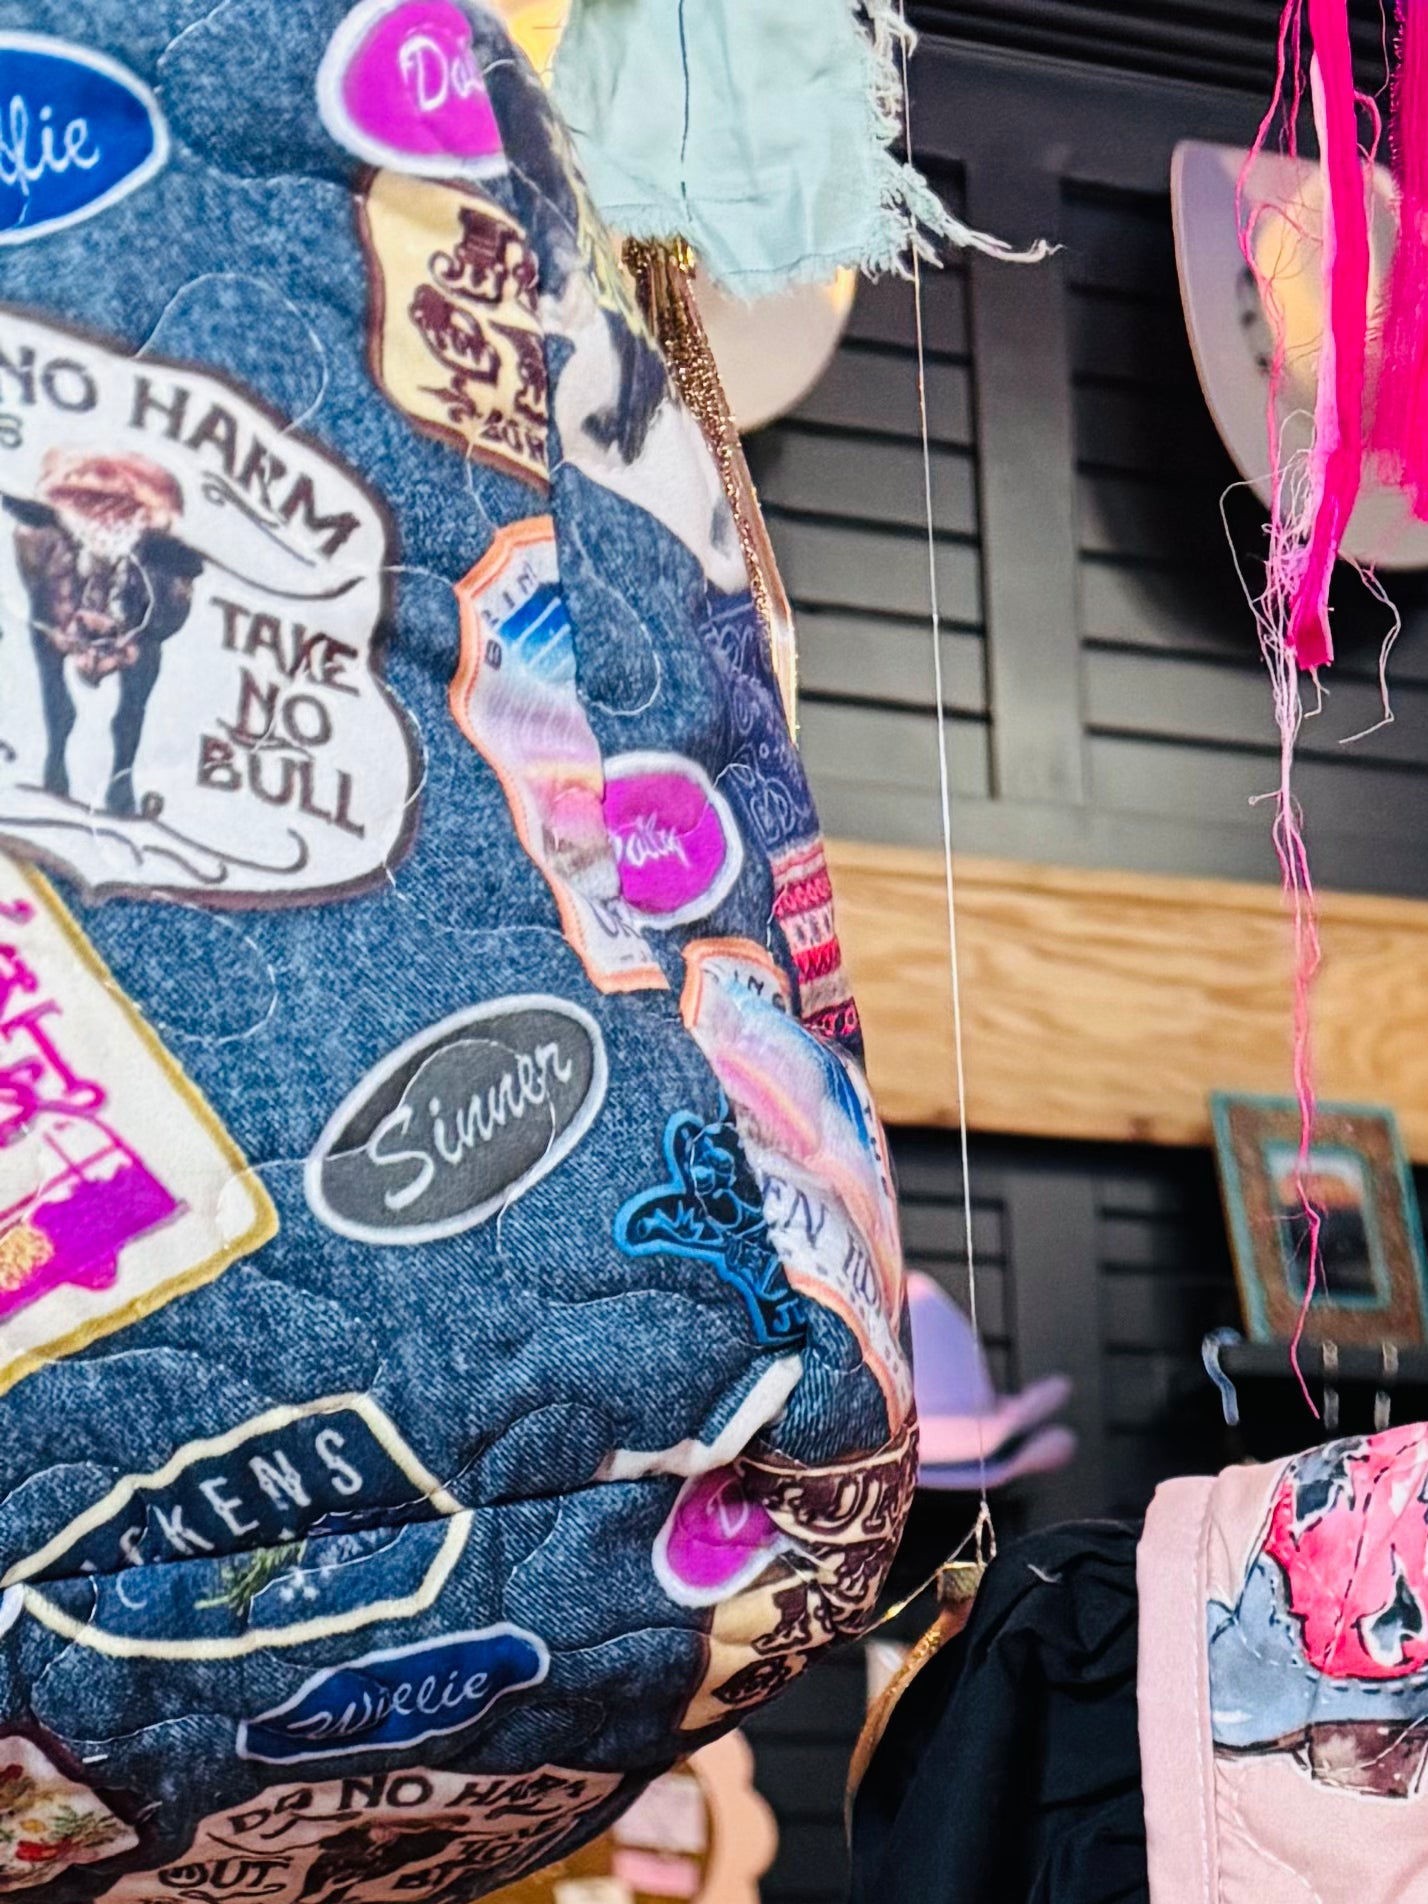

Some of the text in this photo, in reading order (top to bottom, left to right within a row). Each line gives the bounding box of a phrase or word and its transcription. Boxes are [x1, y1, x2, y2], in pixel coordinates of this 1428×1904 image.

[129, 374, 361, 563] HARM
[208, 597, 361, 697] TAKE
[235, 668, 334, 750] NO
[197, 733, 366, 839] BULL
[368, 1042, 573, 1210] Sinner
[286, 1668, 490, 1740] Willie
[340, 1774, 435, 1811] NO
